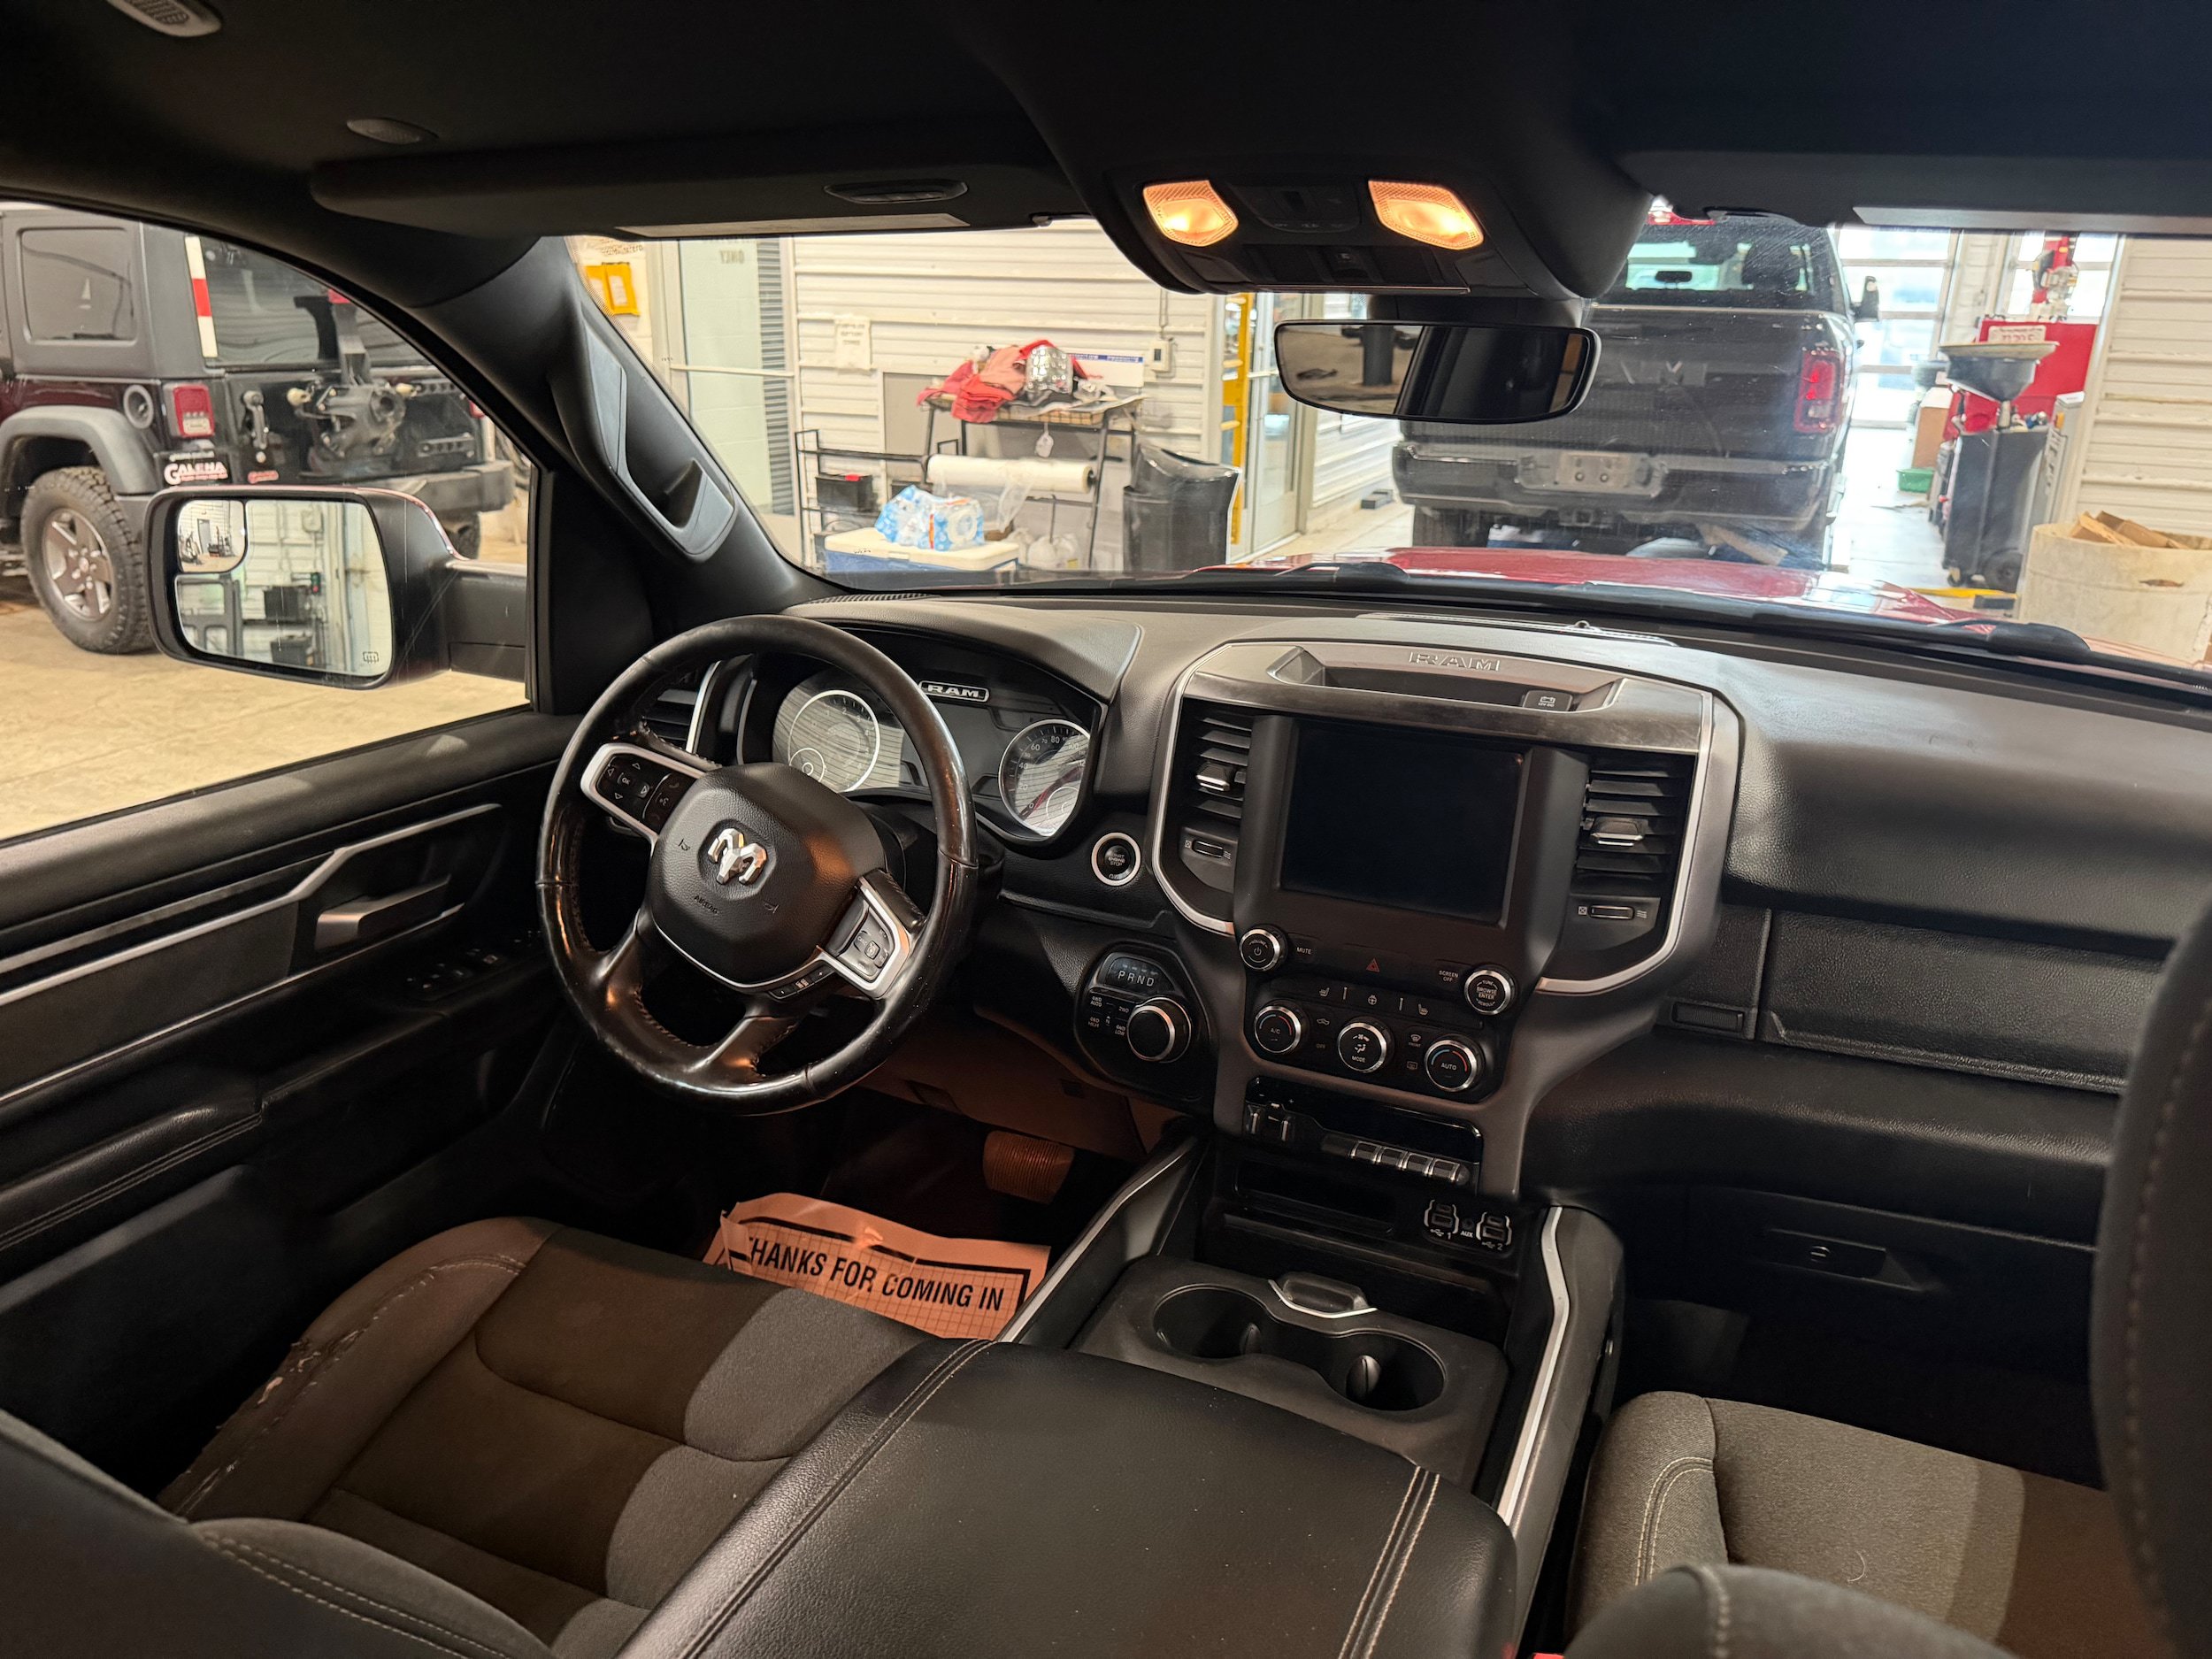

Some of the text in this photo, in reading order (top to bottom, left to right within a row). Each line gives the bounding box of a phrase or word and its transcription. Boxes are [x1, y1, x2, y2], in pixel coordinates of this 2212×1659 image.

[1409, 650, 1501, 672] RAM
[926, 684, 979, 698] RAM
[1440, 1062, 1457, 1071] AUTO
[749, 1236, 1005, 1312] HANKS FOR COMING IN
